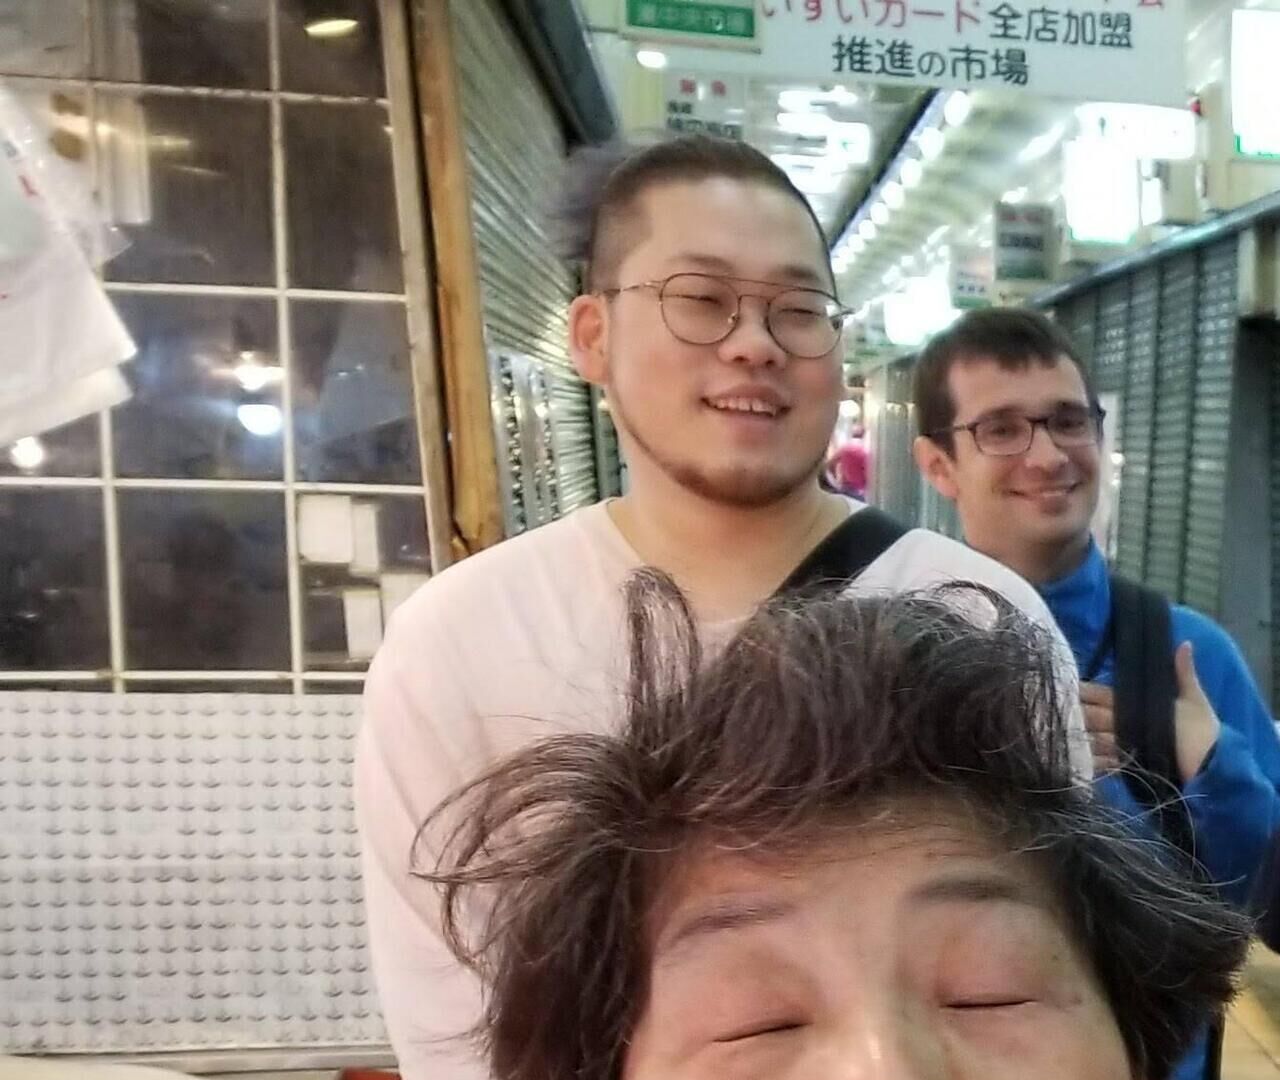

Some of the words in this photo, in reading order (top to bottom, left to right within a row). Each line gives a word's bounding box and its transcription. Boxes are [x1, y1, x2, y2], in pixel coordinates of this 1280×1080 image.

[831, 35, 1030, 86] 推進の市場
